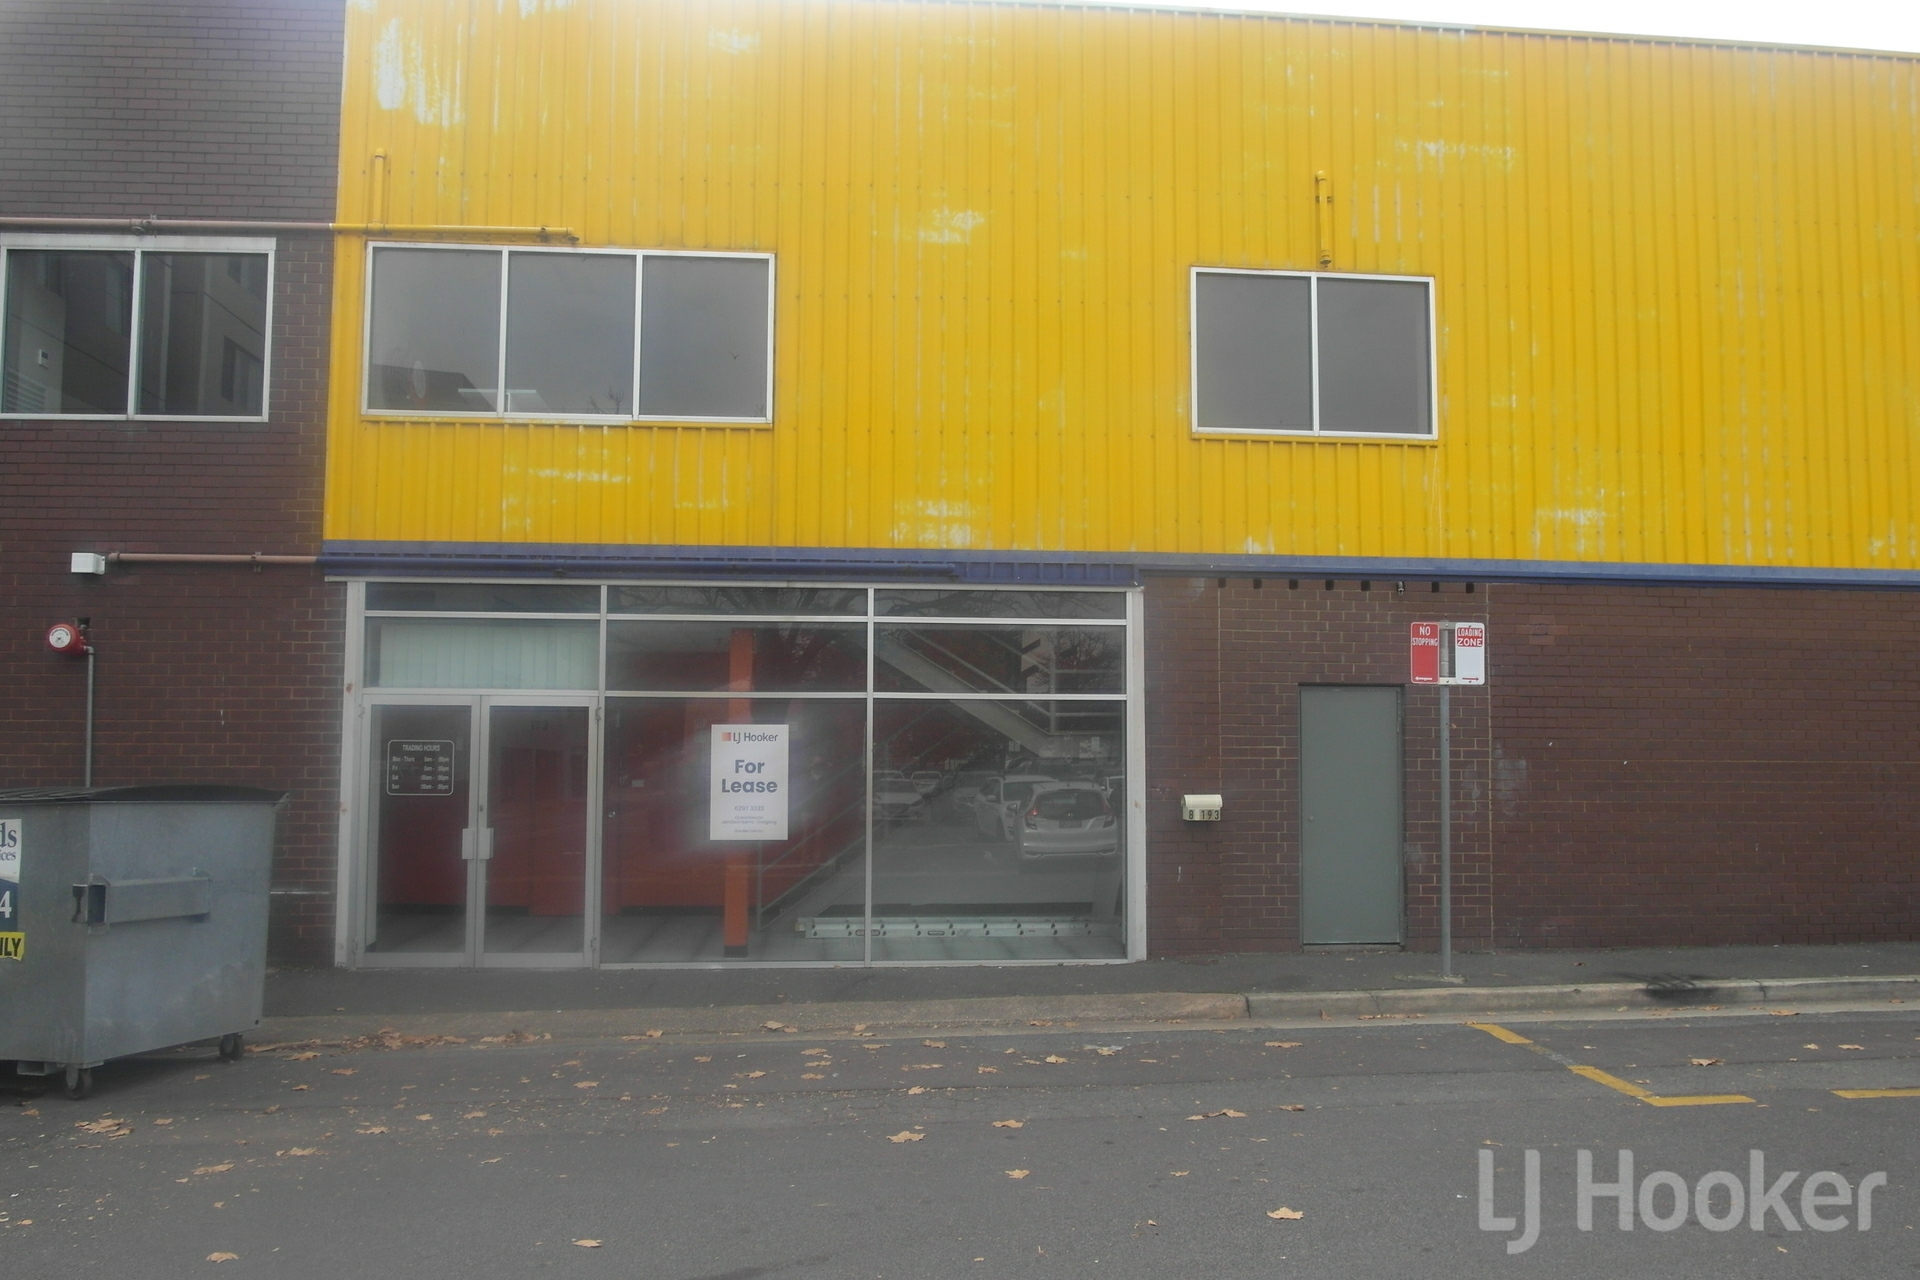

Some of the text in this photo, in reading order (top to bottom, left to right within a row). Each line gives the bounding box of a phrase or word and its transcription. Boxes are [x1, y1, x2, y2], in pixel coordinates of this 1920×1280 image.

[1419, 626, 1431, 636] NO
[1457, 628, 1482, 637] LOADING
[1412, 637, 1438, 646] STOPPING
[1457, 638, 1483, 646] ZONE
[733, 732, 778, 744] LJ Hooker
[735, 759, 765, 774] For
[721, 779, 778, 793] Lease
[1189, 809, 1219, 820] 8 193
